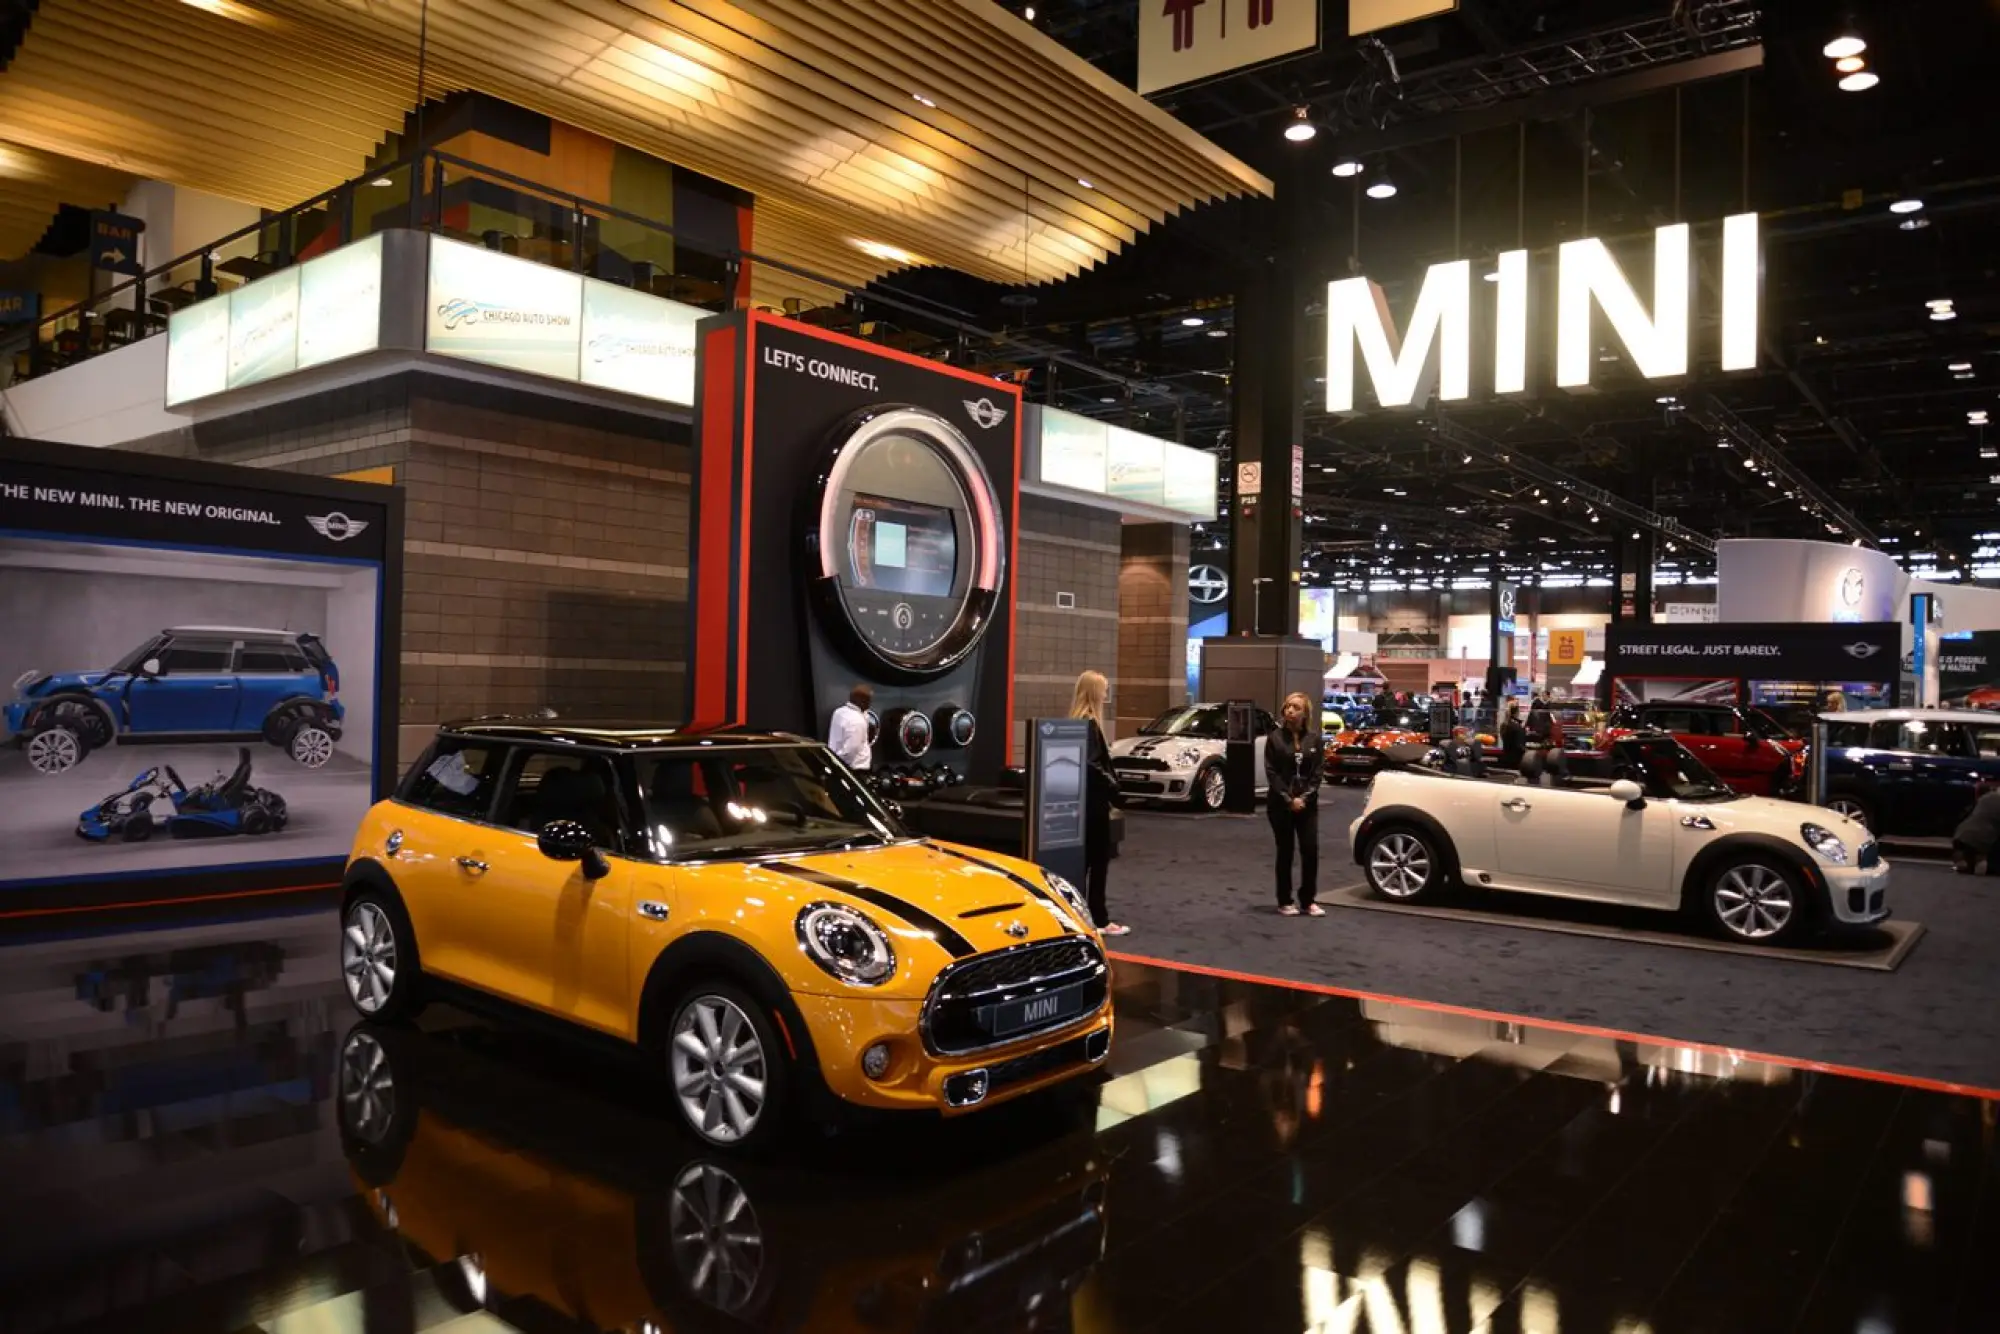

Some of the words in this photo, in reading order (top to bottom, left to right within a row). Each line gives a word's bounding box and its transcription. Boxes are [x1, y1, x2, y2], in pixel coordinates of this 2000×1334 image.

[483, 310, 521, 324] CHICAGO
[523, 312, 545, 325] AUTO
[546, 314, 571, 326] SHOW
[1326, 212, 1759, 413] MINI
[764, 347, 804, 373] LET'S
[808, 359, 879, 392] CONNECT.
[33, 487, 76, 504] NEW
[80, 492, 125, 510] MINI.
[130, 497, 161, 513] THE
[165, 502, 201, 517] NEW
[205, 505, 281, 525] ORIGINAL.
[1619, 644, 1659, 656] STREET
[1660, 644, 1700, 656] LEGAL.
[1702, 644, 1731, 656] JUST
[1733, 644, 1781, 657] BARELY.
[1024, 996, 1059, 1023] MINI
